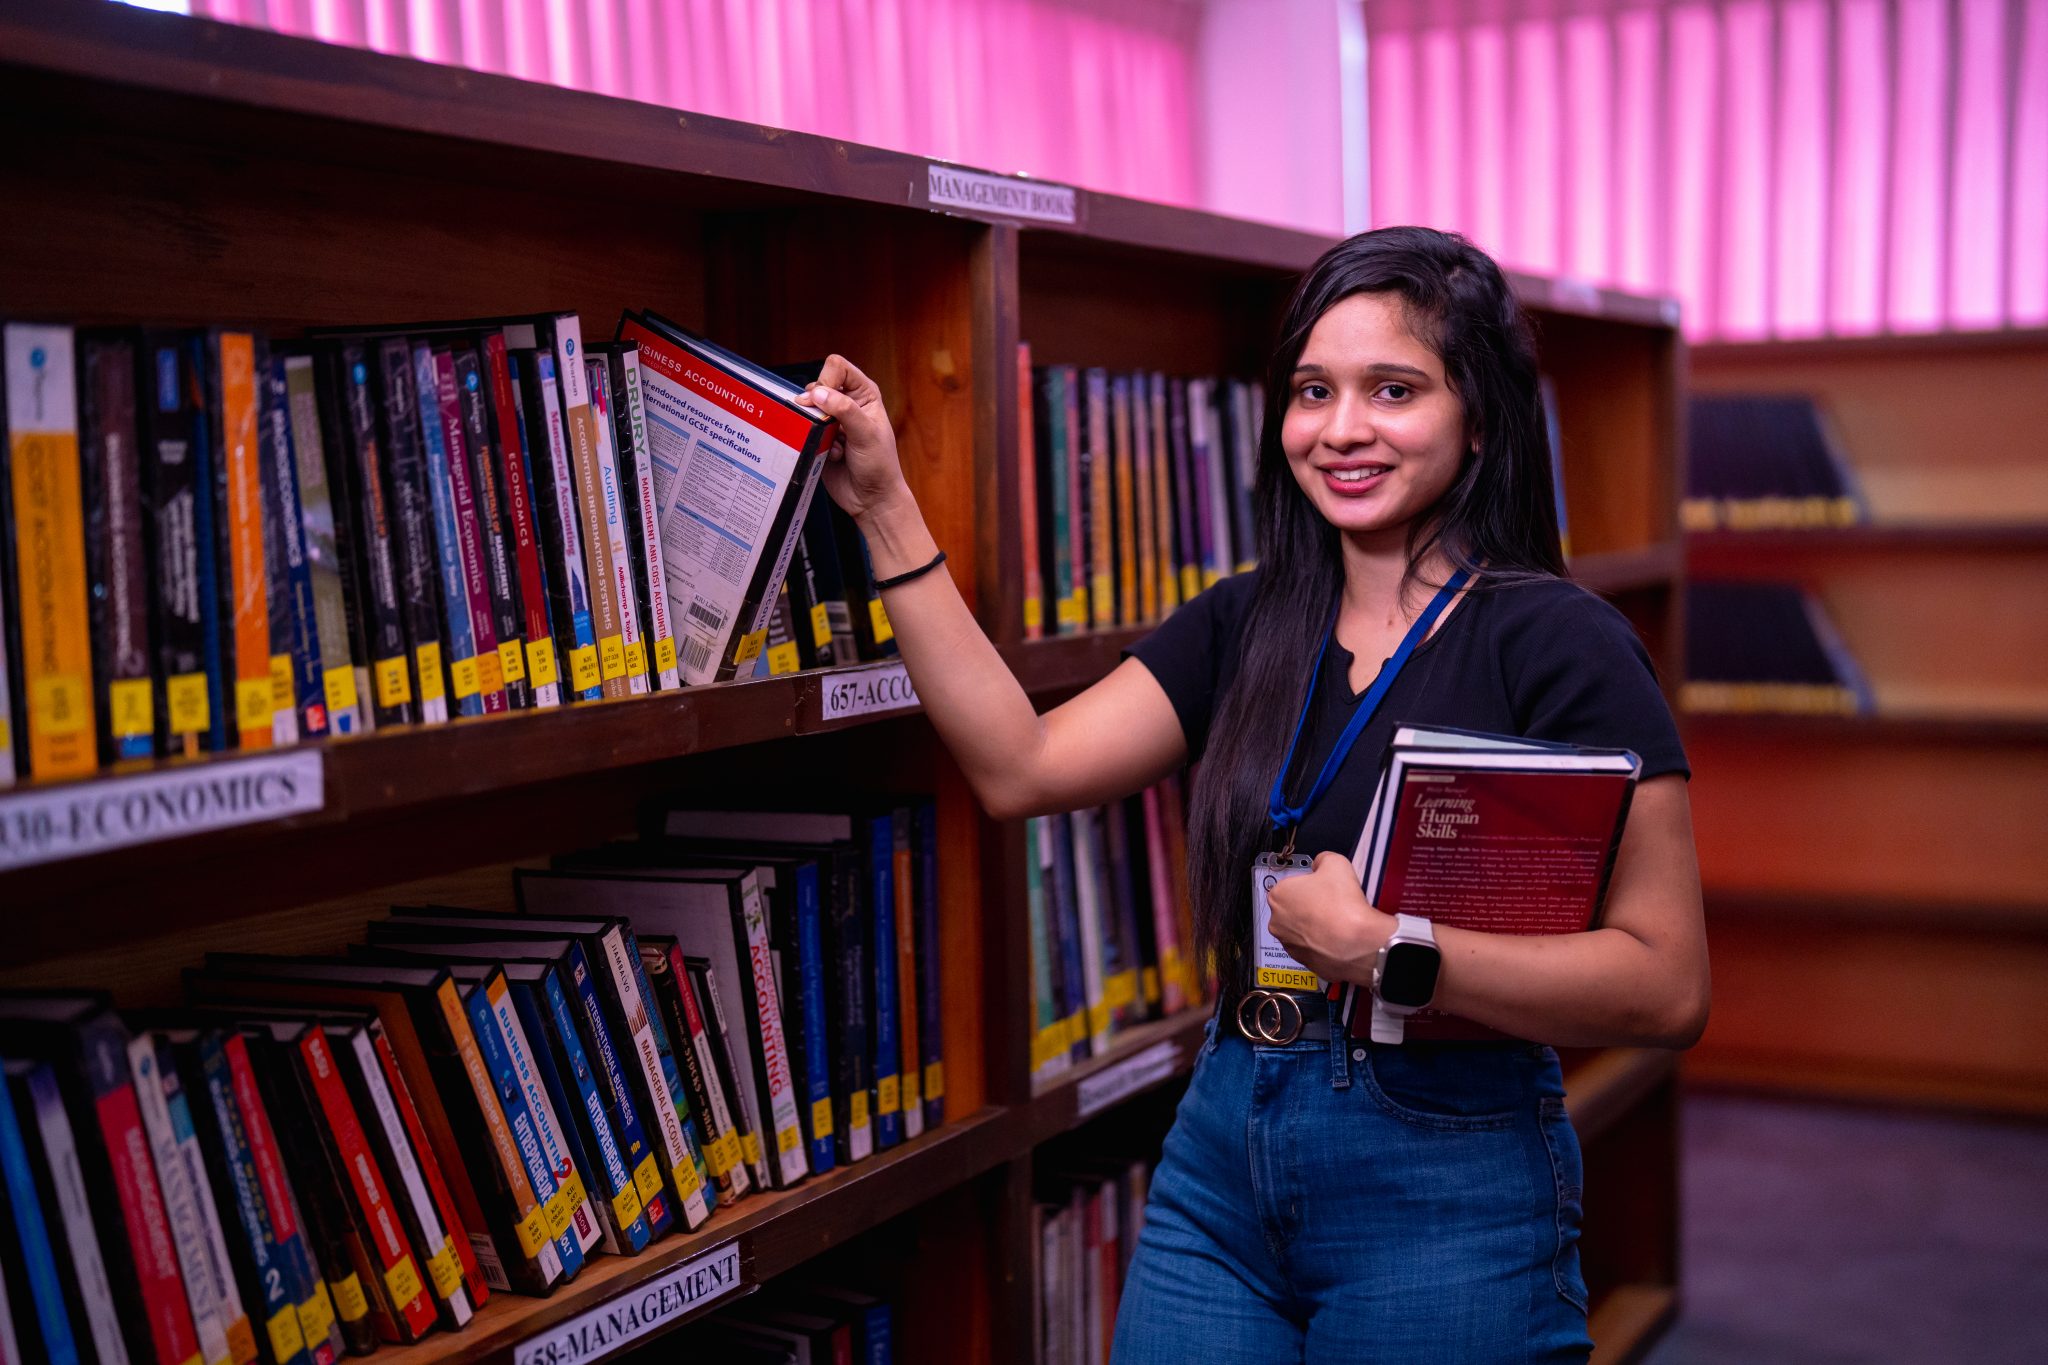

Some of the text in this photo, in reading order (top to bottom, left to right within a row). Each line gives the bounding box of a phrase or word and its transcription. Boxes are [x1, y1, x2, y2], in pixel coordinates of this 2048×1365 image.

[929, 173, 1027, 210] MANAGEMENT
[626, 367, 646, 455] DRURY
[634, 339, 764, 419] USINESS ACCOUNTING 1
[641, 375, 751, 444] el-endorsed resources for the
[688, 417, 709, 435] GCSE
[708, 428, 762, 464] specifications
[448, 417, 482, 595] Managerial Economics
[509, 452, 528, 547] ECONOMICS
[550, 410, 576, 557] Managerial Accounting
[604, 466, 617, 525] Auditing
[642, 477, 656, 541] MANAGEMENT
[577, 417, 612, 631] ACCOUNTING INFORMATION SYSTEMS
[648, 543, 657, 562] AND
[774, 519, 800, 579] BUSINESS
[494, 535, 510, 600] MANAGEMENT
[650, 564, 660, 588] COST
[618, 566, 633, 643] Millichamp & Taylor
[830, 676, 914, 711] 657-ACCO
[1414, 793, 1476, 814] Learning
[1416, 823, 1458, 840] Skills
[1420, 809, 1479, 825] Human
[1262, 971, 1317, 987] STUDENT
[749, 944, 786, 1099] ACCOUNTING
[587, 993, 634, 1127] INTERNATIONAL BUSINESS
[640, 1037, 667, 1112] MANAGERIAL
[684, 1046, 702, 1093] STOCKS
[469, 1056, 500, 1127] LEADERSHIP
[496, 1125, 524, 1191] EXPERIENCE
[499, 1006, 530, 1081] BUSINESS
[553, 1157, 573, 1189] 2
[566, 1184, 576, 1198] KIU
[265, 1268, 284, 1301] 2
